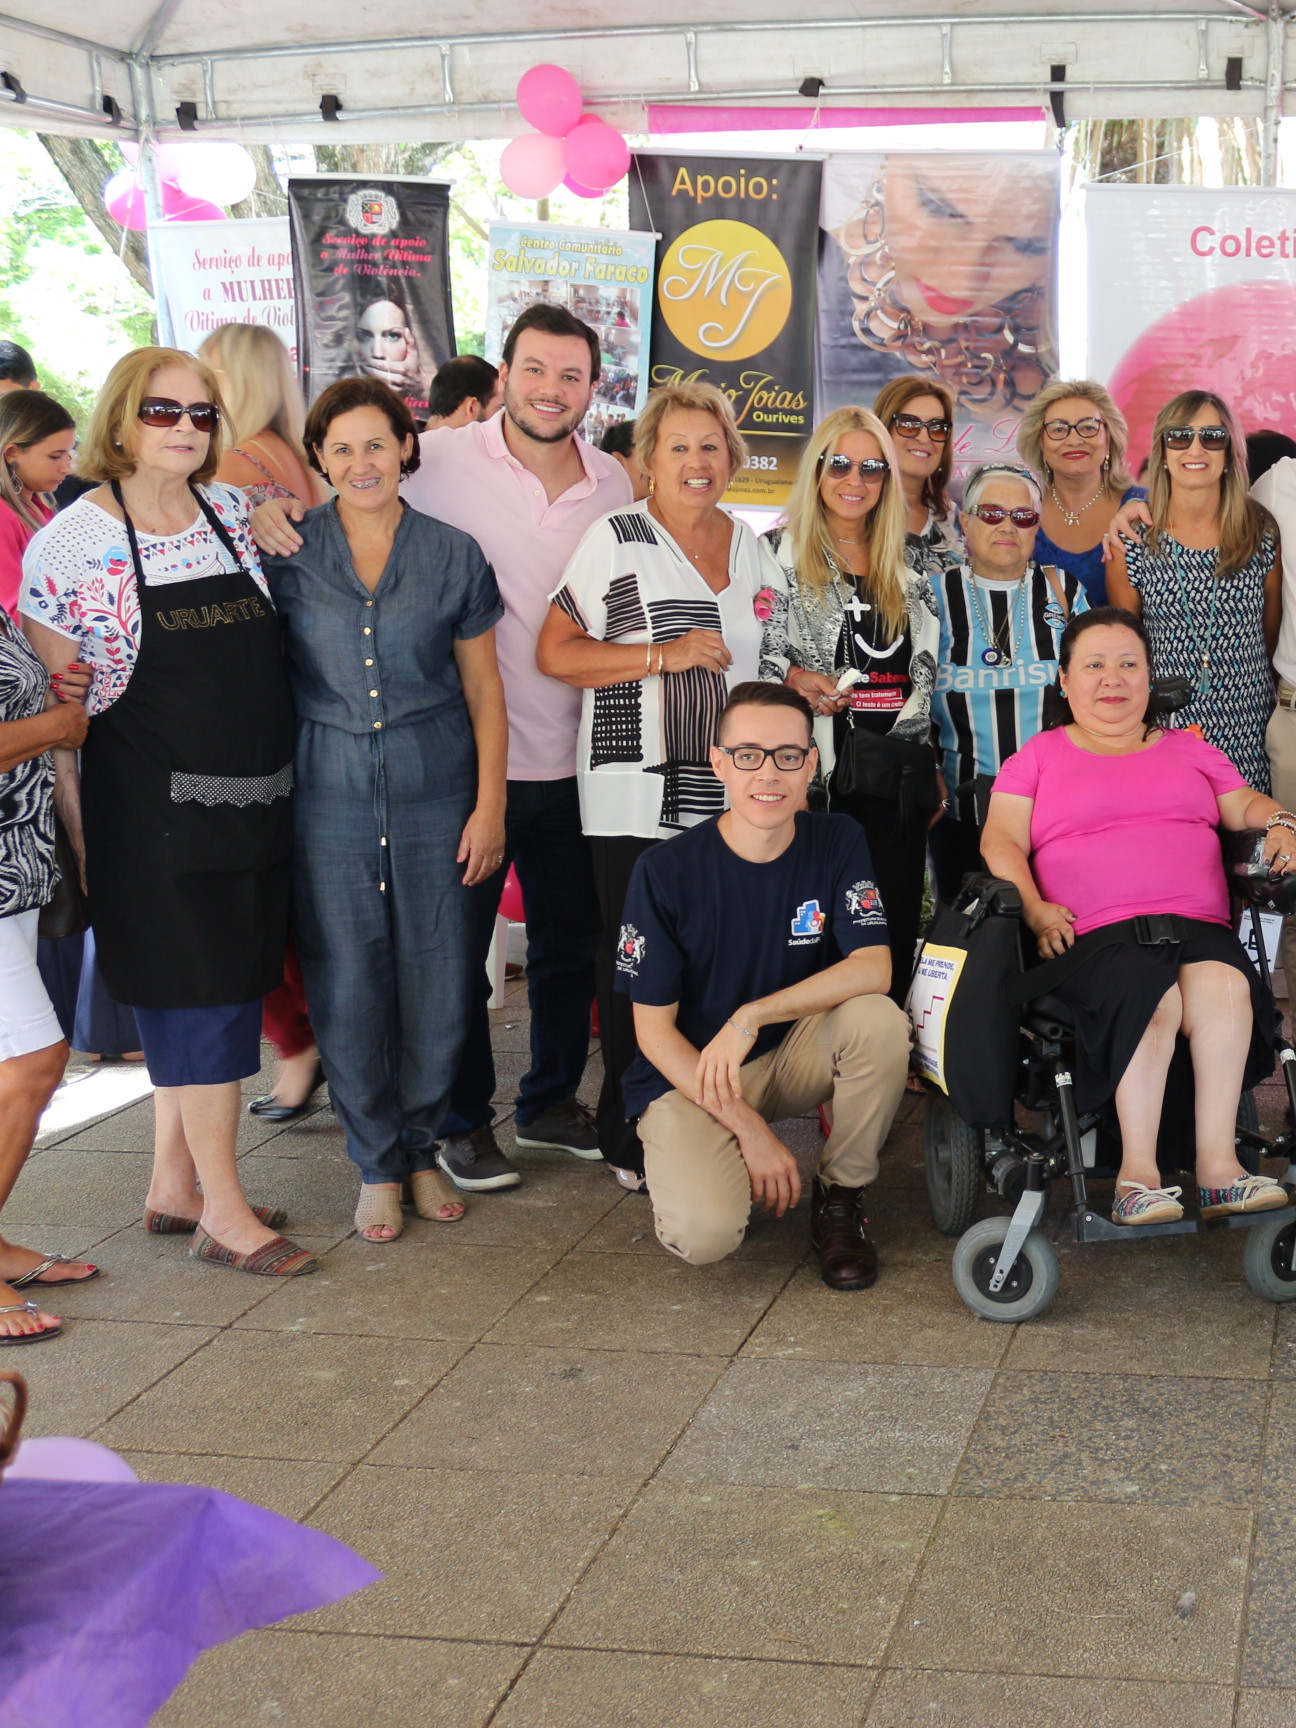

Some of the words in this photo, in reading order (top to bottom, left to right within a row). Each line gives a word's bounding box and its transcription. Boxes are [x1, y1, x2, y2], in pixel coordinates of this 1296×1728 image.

[671, 166, 778, 205] Apoio:
[371, 234, 387, 246] de
[391, 236, 427, 248] apoio
[520, 235, 555, 250] Centro
[558, 239, 623, 256] Comunitário
[192, 248, 242, 274] Serviço
[247, 246, 262, 267] de
[333, 263, 349, 275] de
[492, 247, 579, 278] Salvador
[583, 256, 649, 284] Faraco
[203, 287, 213, 301] a
[752, 410, 805, 424] Ourives
[156, 597, 265, 631] URUARTE
